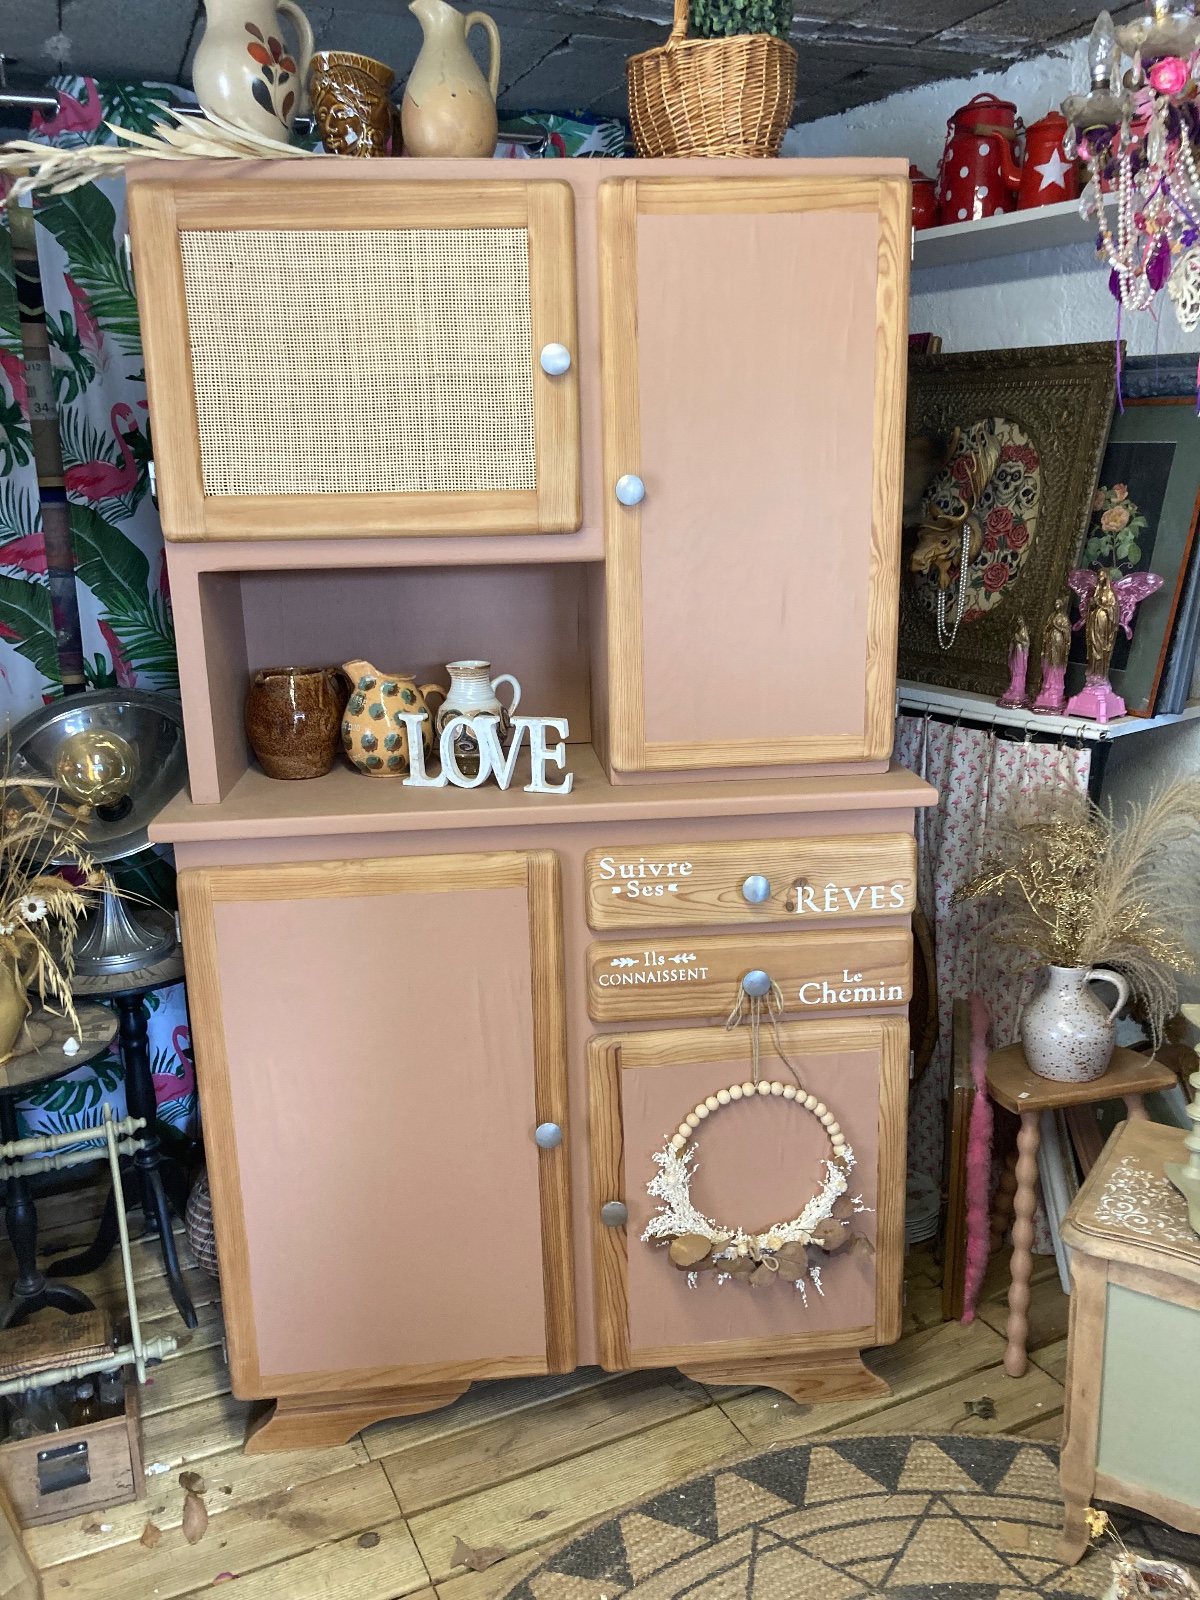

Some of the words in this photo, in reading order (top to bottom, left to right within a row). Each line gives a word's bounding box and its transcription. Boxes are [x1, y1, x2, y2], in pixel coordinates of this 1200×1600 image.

[398, 712, 574, 794] LOVE
[599, 857, 693, 879] Suivre
[626, 880, 664, 898] Ses
[795, 883, 905, 914] RÊVES
[643, 951, 665, 967] Ils
[599, 967, 709, 987] CONNAISSENT
[842, 969, 863, 983] Le
[798, 981, 904, 1005] Chemin
